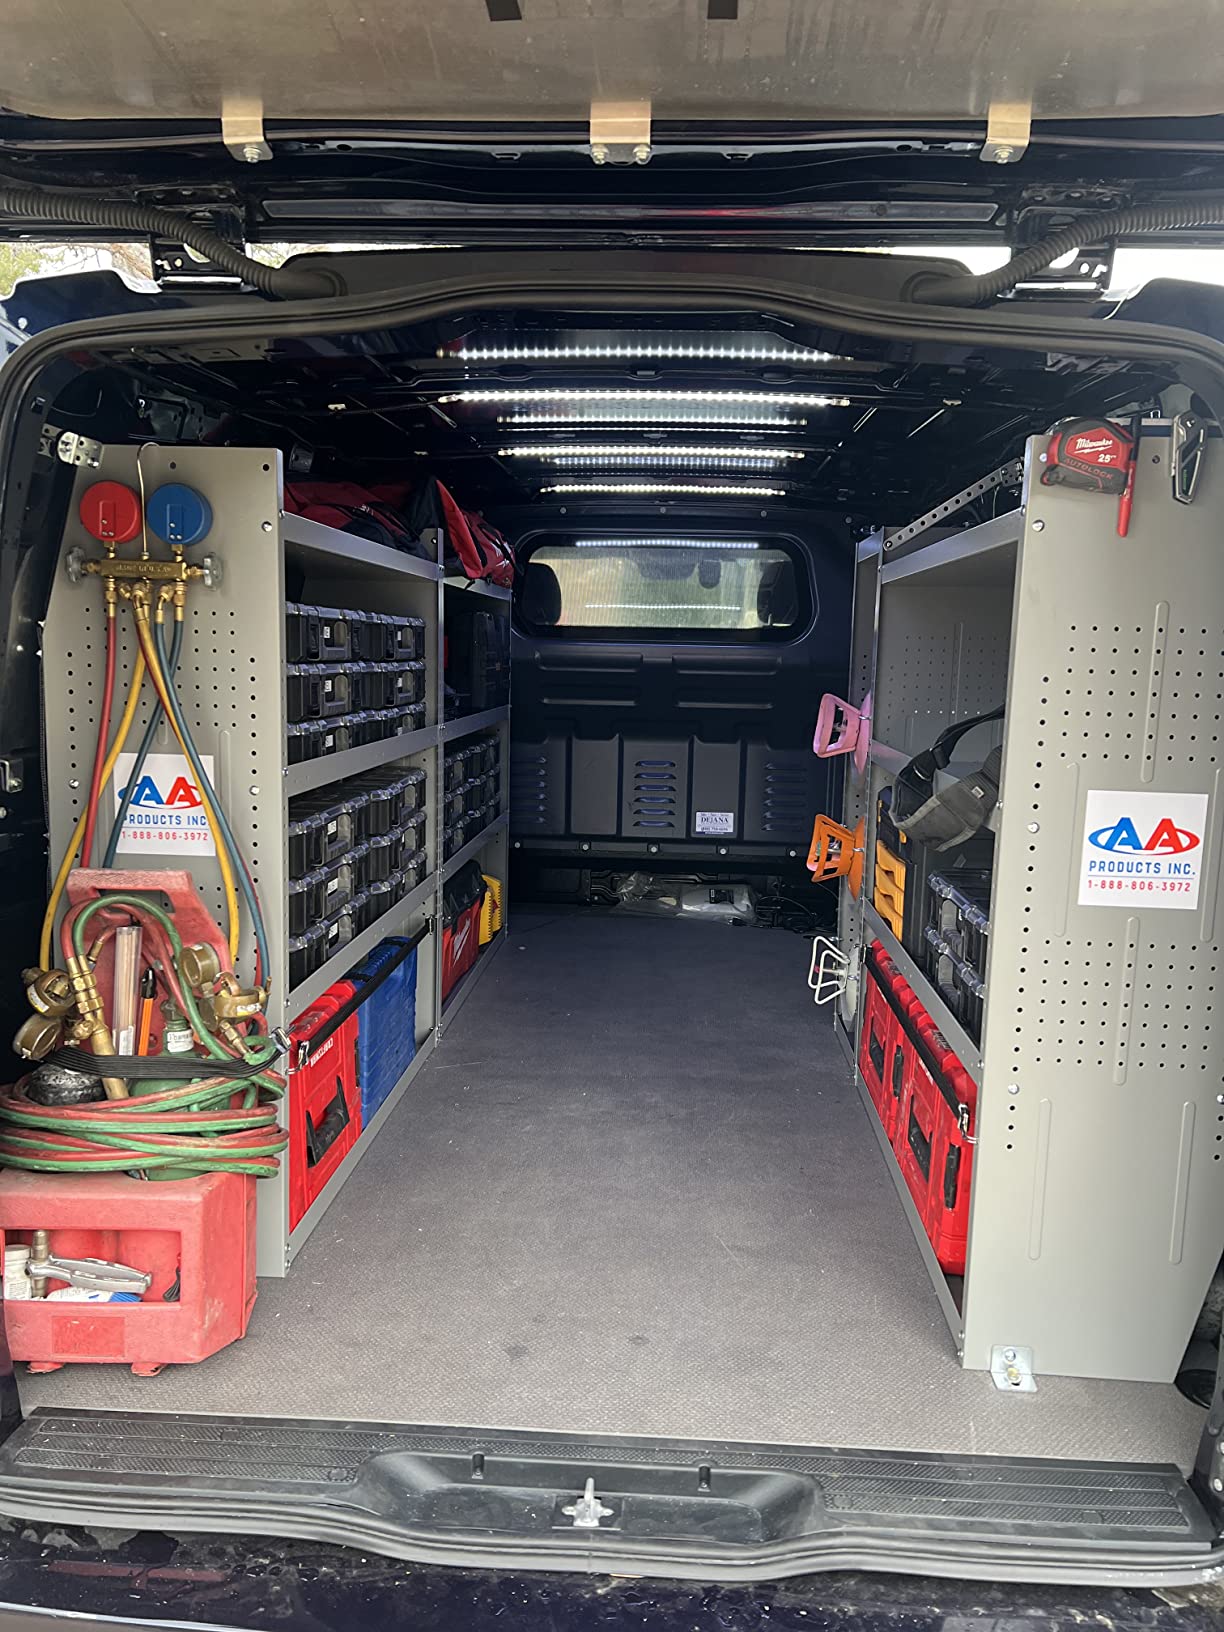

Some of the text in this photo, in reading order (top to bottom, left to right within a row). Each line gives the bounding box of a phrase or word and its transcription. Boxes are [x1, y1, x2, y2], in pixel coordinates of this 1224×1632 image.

[1076, 438, 1113, 450] Milwaukee
[1065, 458, 1114, 480] AUTOLOCK
[131, 775, 199, 806] AA
[125, 814, 182, 825] RODUCTS
[122, 831, 208, 841] 1-888-806-3972
[1103, 817, 1184, 852] AA
[1089, 860, 1196, 875] PRODUCTS INC.
[1088, 879, 1191, 892] 1-888-806-3972
